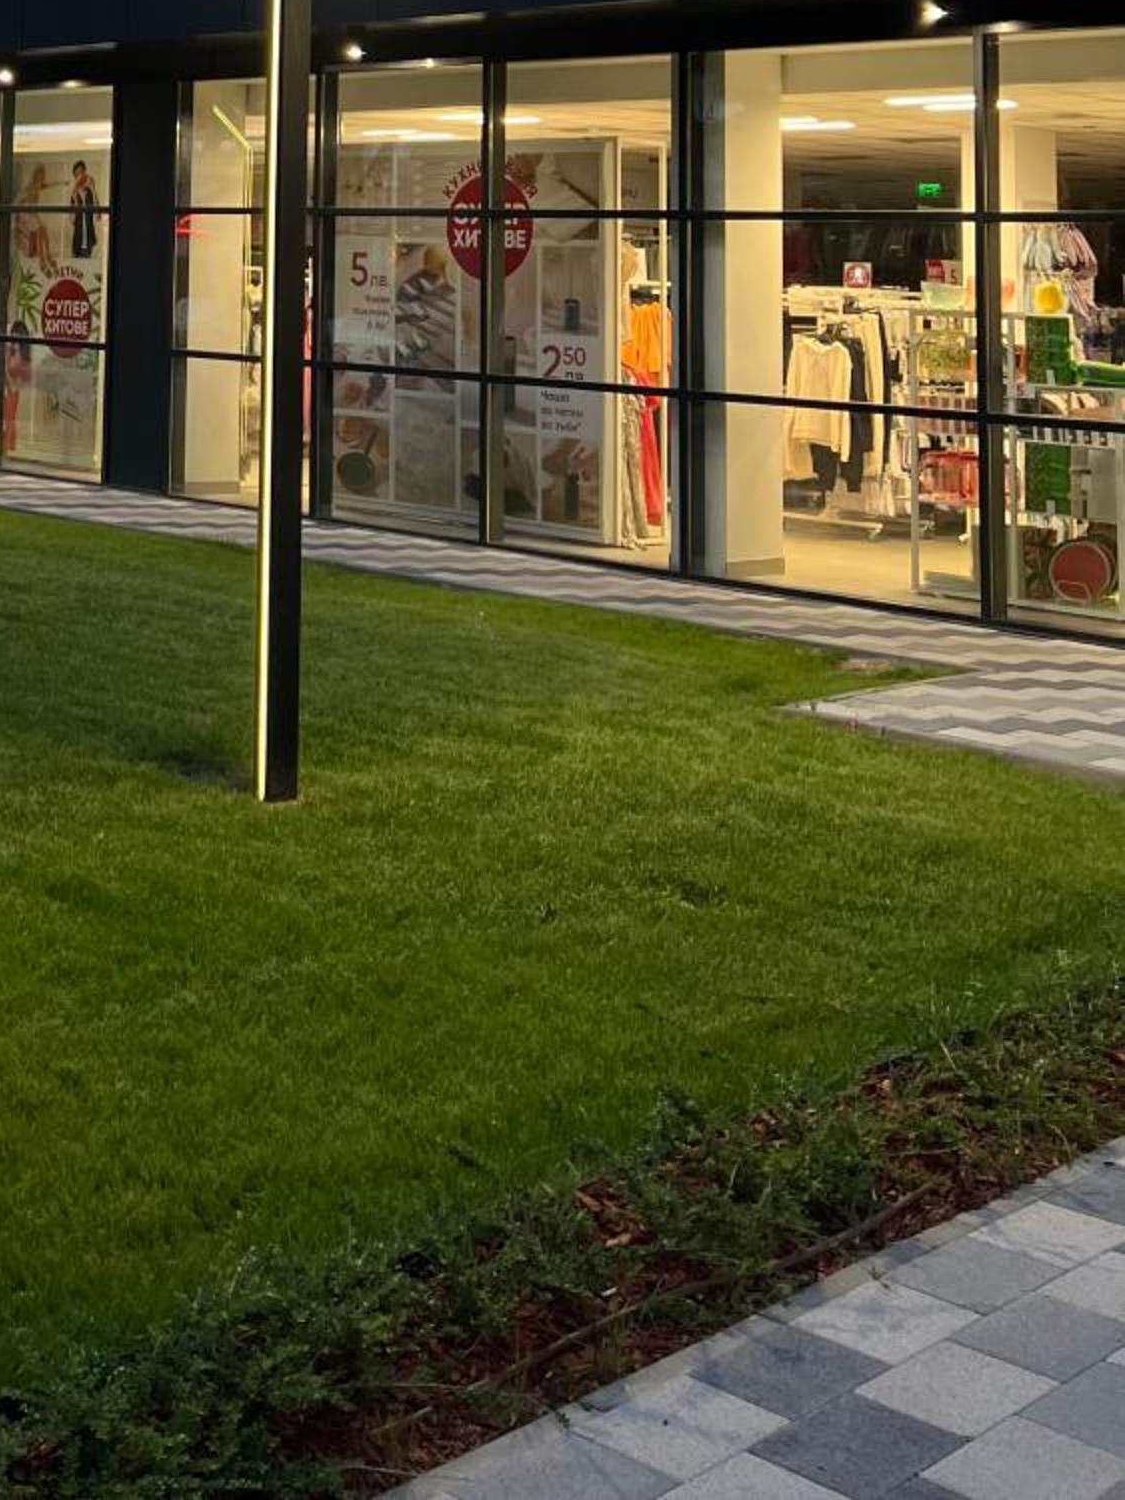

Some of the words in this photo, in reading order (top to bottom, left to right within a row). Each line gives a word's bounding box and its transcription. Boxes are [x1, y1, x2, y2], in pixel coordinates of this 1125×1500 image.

[453, 229, 526, 248] ХИВЕ
[350, 251, 368, 286] 5
[44, 299, 89, 318] СУПЕР
[44, 318, 88, 336] ХИТОВЕ
